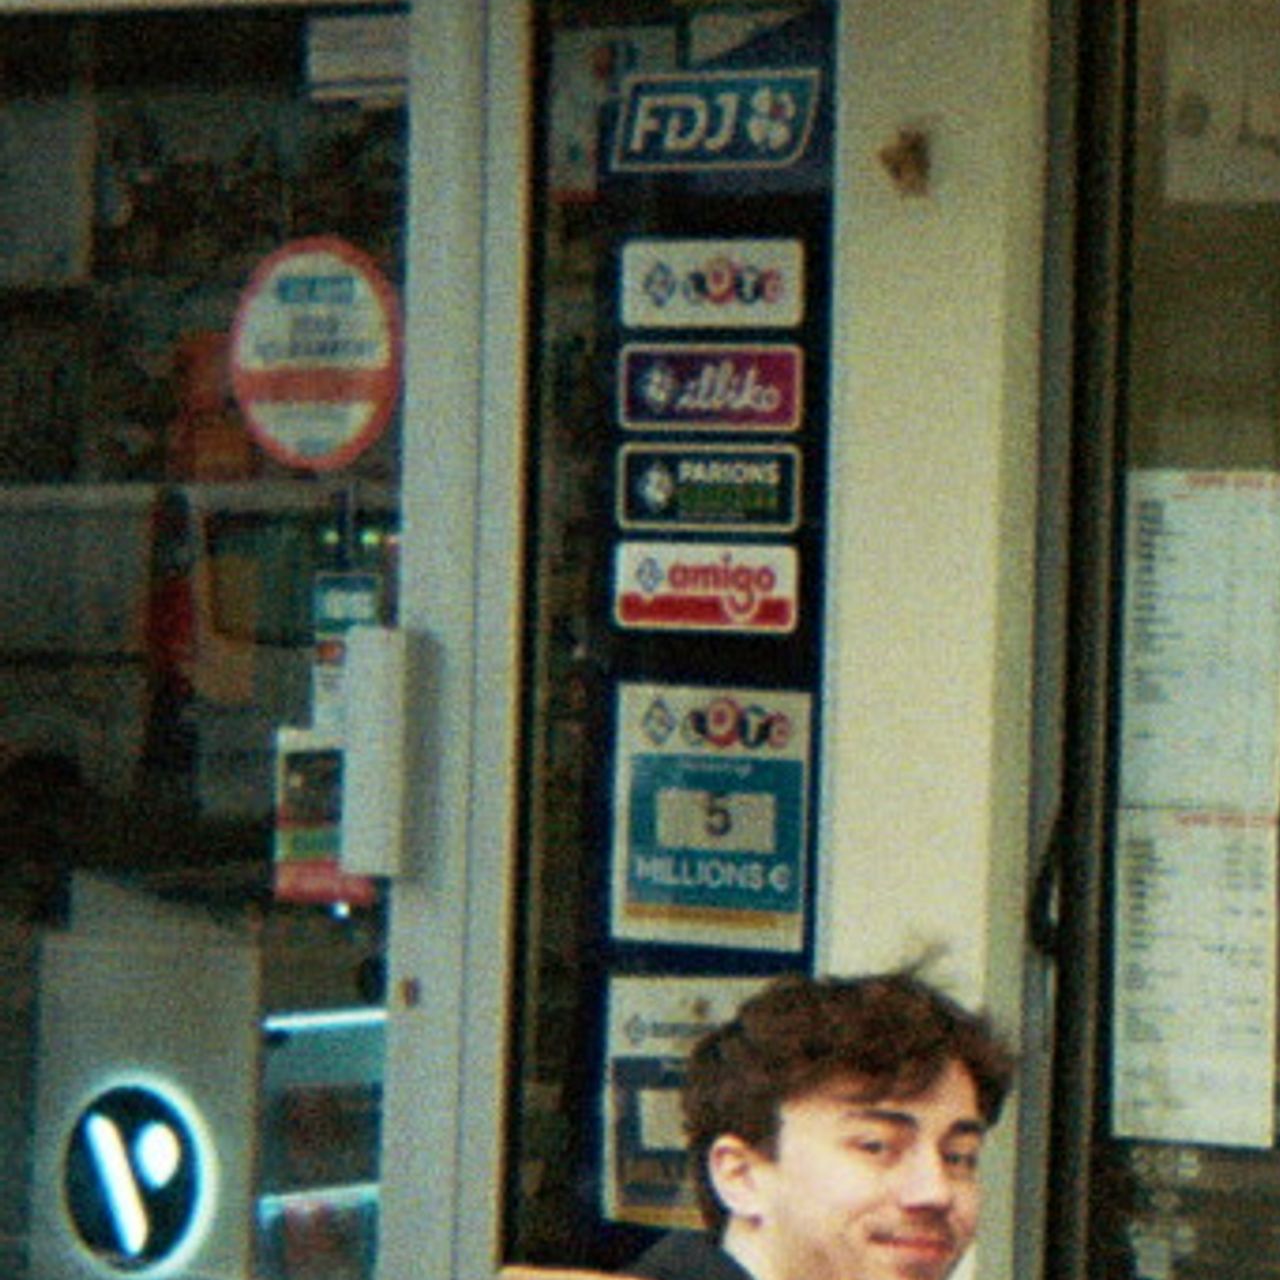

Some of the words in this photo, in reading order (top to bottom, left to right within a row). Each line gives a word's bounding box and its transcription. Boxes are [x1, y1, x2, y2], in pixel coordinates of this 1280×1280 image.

[629, 92, 740, 152] FDJ
[678, 460, 782, 486] PARIONS
[668, 551, 777, 614] amigo
[704, 793, 732, 837] 5
[634, 856, 765, 891] MILLIONS
